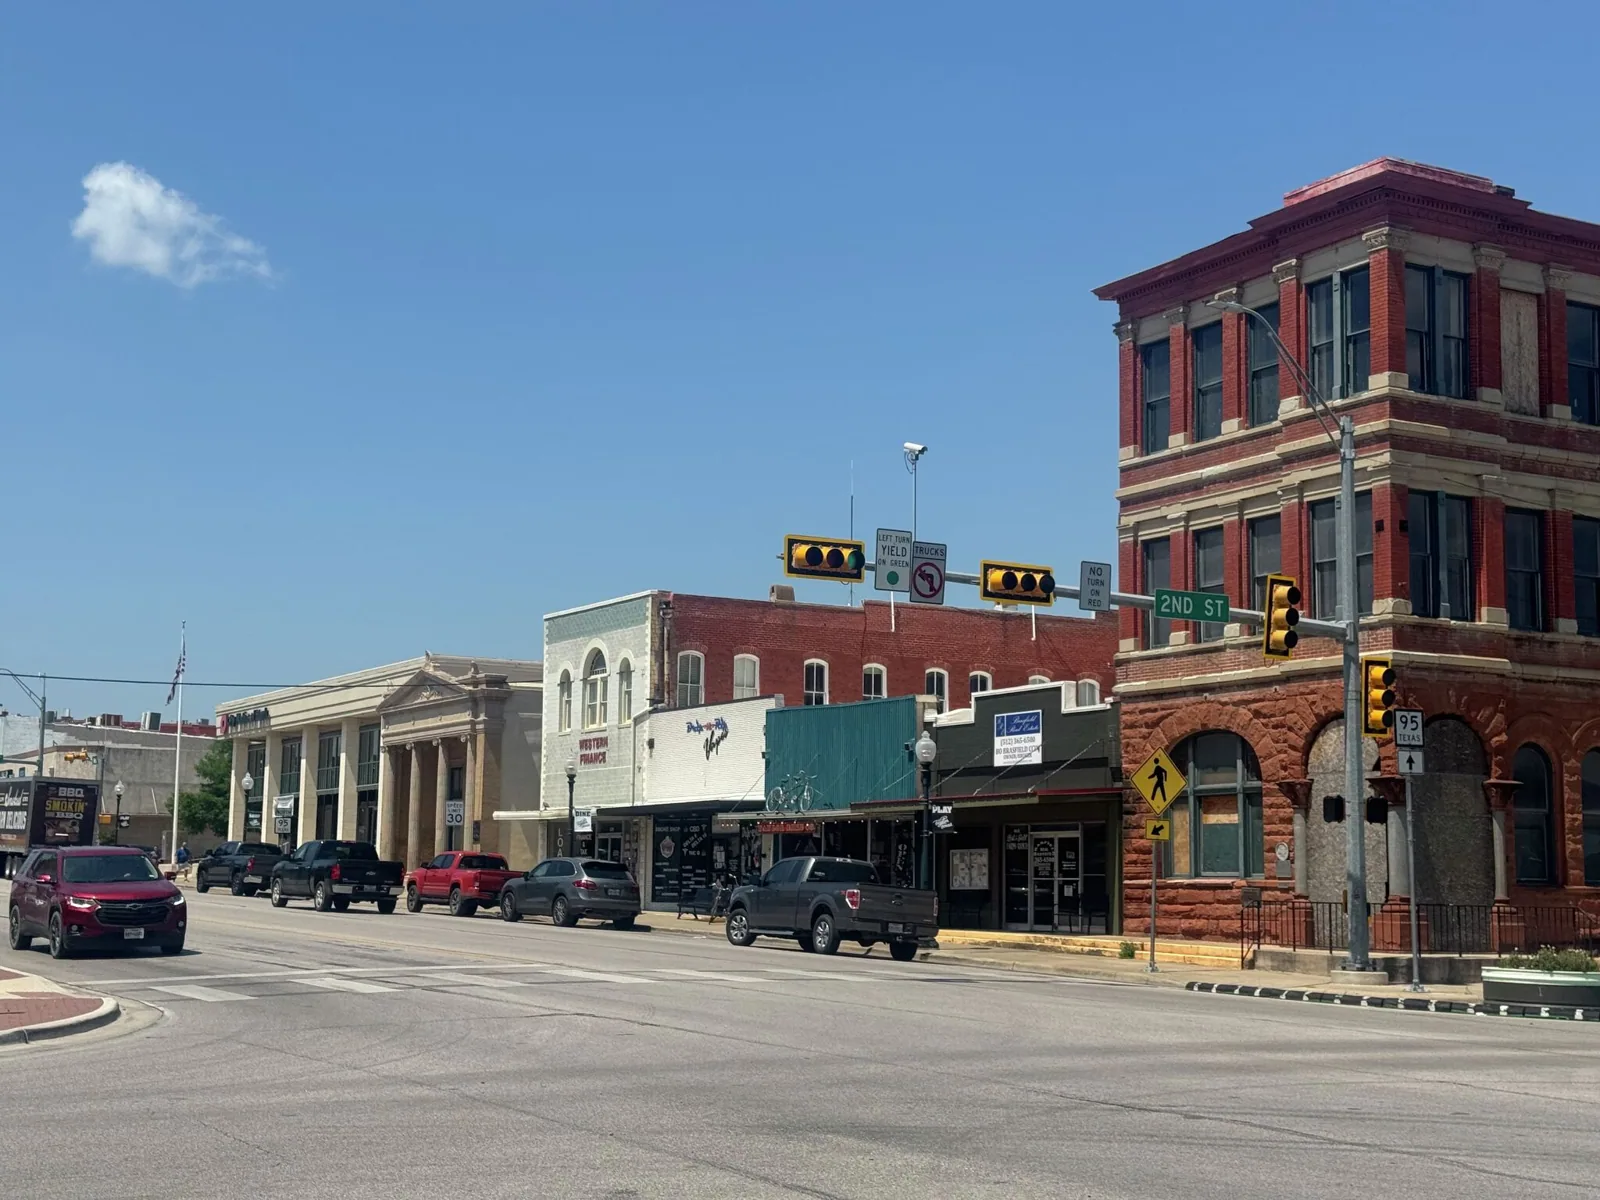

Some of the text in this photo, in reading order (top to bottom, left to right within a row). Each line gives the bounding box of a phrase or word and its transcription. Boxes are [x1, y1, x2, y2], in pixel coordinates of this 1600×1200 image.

[879, 534, 910, 544] LEFT TURN
[882, 545, 907, 557] YIELD
[915, 545, 945, 557] TRUCKS
[890, 560, 909, 568] GREEN
[1089, 567, 1103, 577] NO
[1087, 578, 1105, 588] TURN
[1087, 598, 1102, 608] RED
[1160, 594, 1224, 618] 2ND ST
[1400, 714, 1419, 731] 95
[1399, 733, 1420, 742] TEXAS
[579, 736, 609, 750] WESTERN
[579, 751, 607, 766] FINANCE
[58, 787, 84, 798] BBQ
[932, 806, 952, 814] PLAY
[56, 812, 83, 820] BBQ
[447, 813, 462, 823] 30
